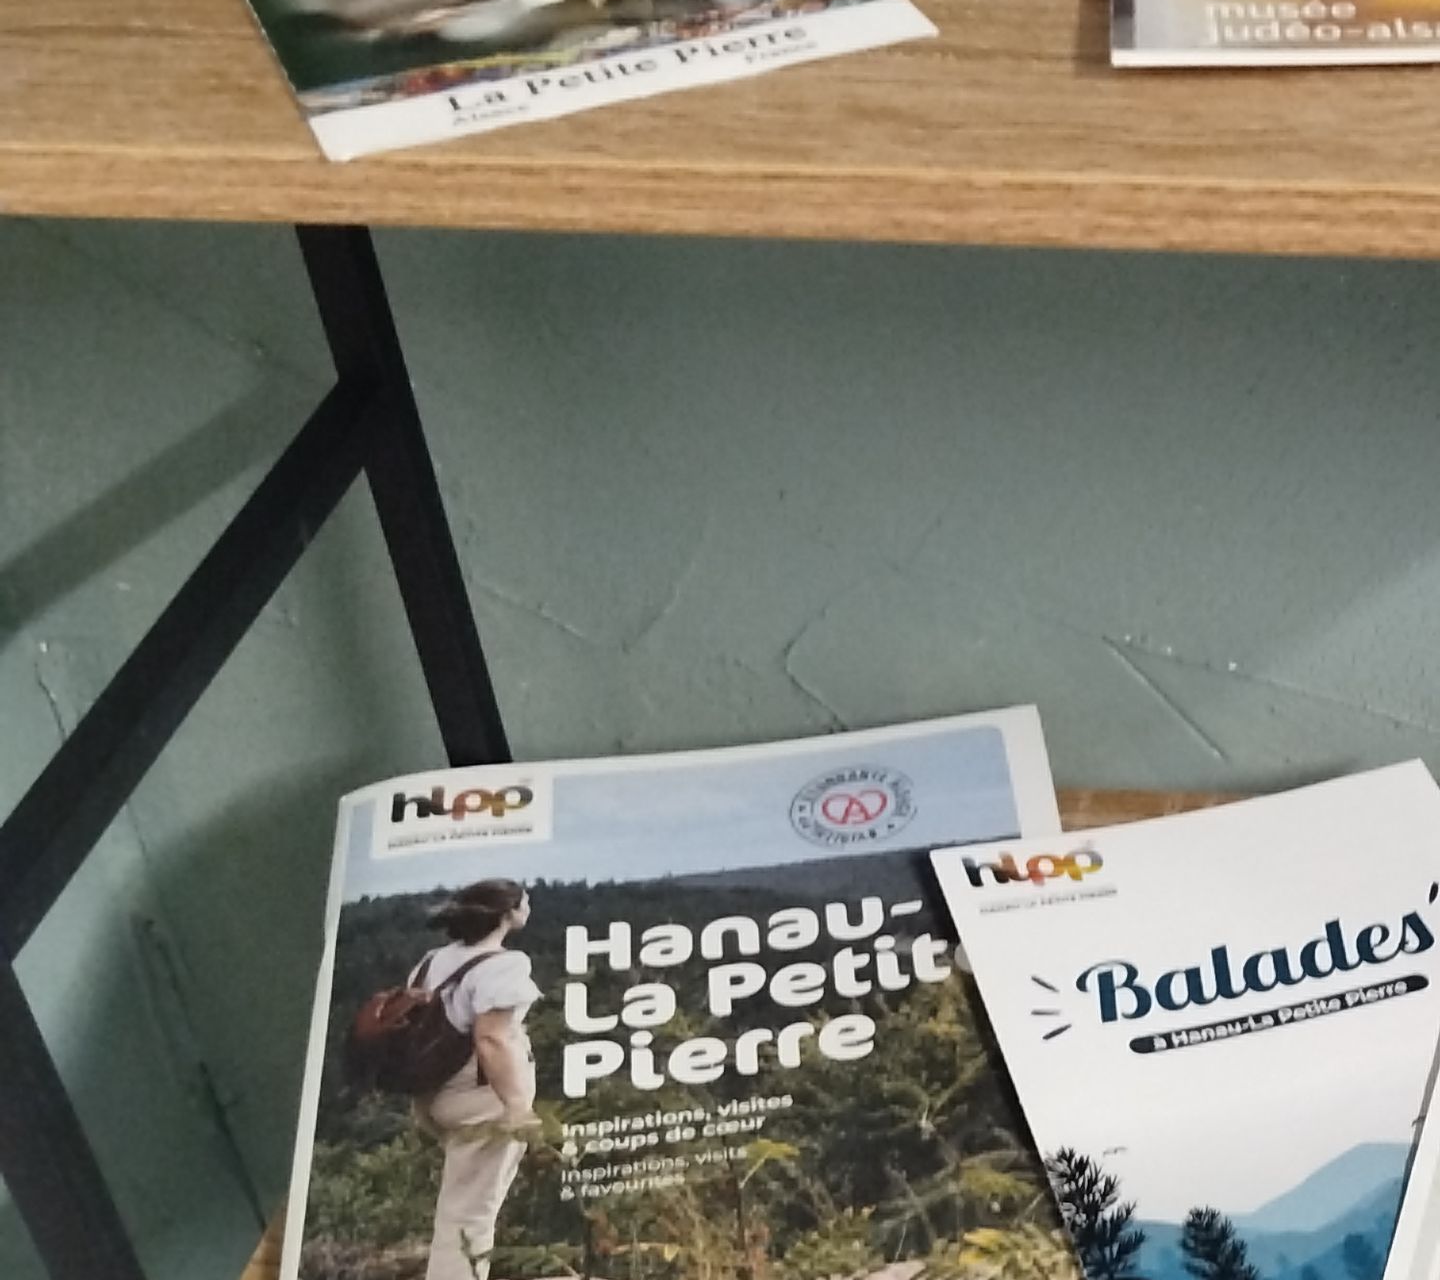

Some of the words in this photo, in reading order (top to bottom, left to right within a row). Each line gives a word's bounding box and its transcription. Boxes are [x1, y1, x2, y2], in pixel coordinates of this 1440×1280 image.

[447, 87, 505, 112] La
[525, 58, 659, 97] Petite
[673, 26, 807, 65] Pierre
[564, 895, 924, 976] Hanau-
[1076, 909, 1437, 1024] Balades
[564, 981, 677, 1035] La
[1278, 996, 1342, 1025] Petite
[1345, 980, 1408, 1007] Pierre
[562, 1012, 877, 1100] Pierre
[562, 1106, 712, 1139] Inspirations,
[717, 1094, 794, 1118] visites
[585, 1131, 660, 1153] coups
[665, 1126, 697, 1143] de
[561, 1154, 690, 1185] Inspirations,
